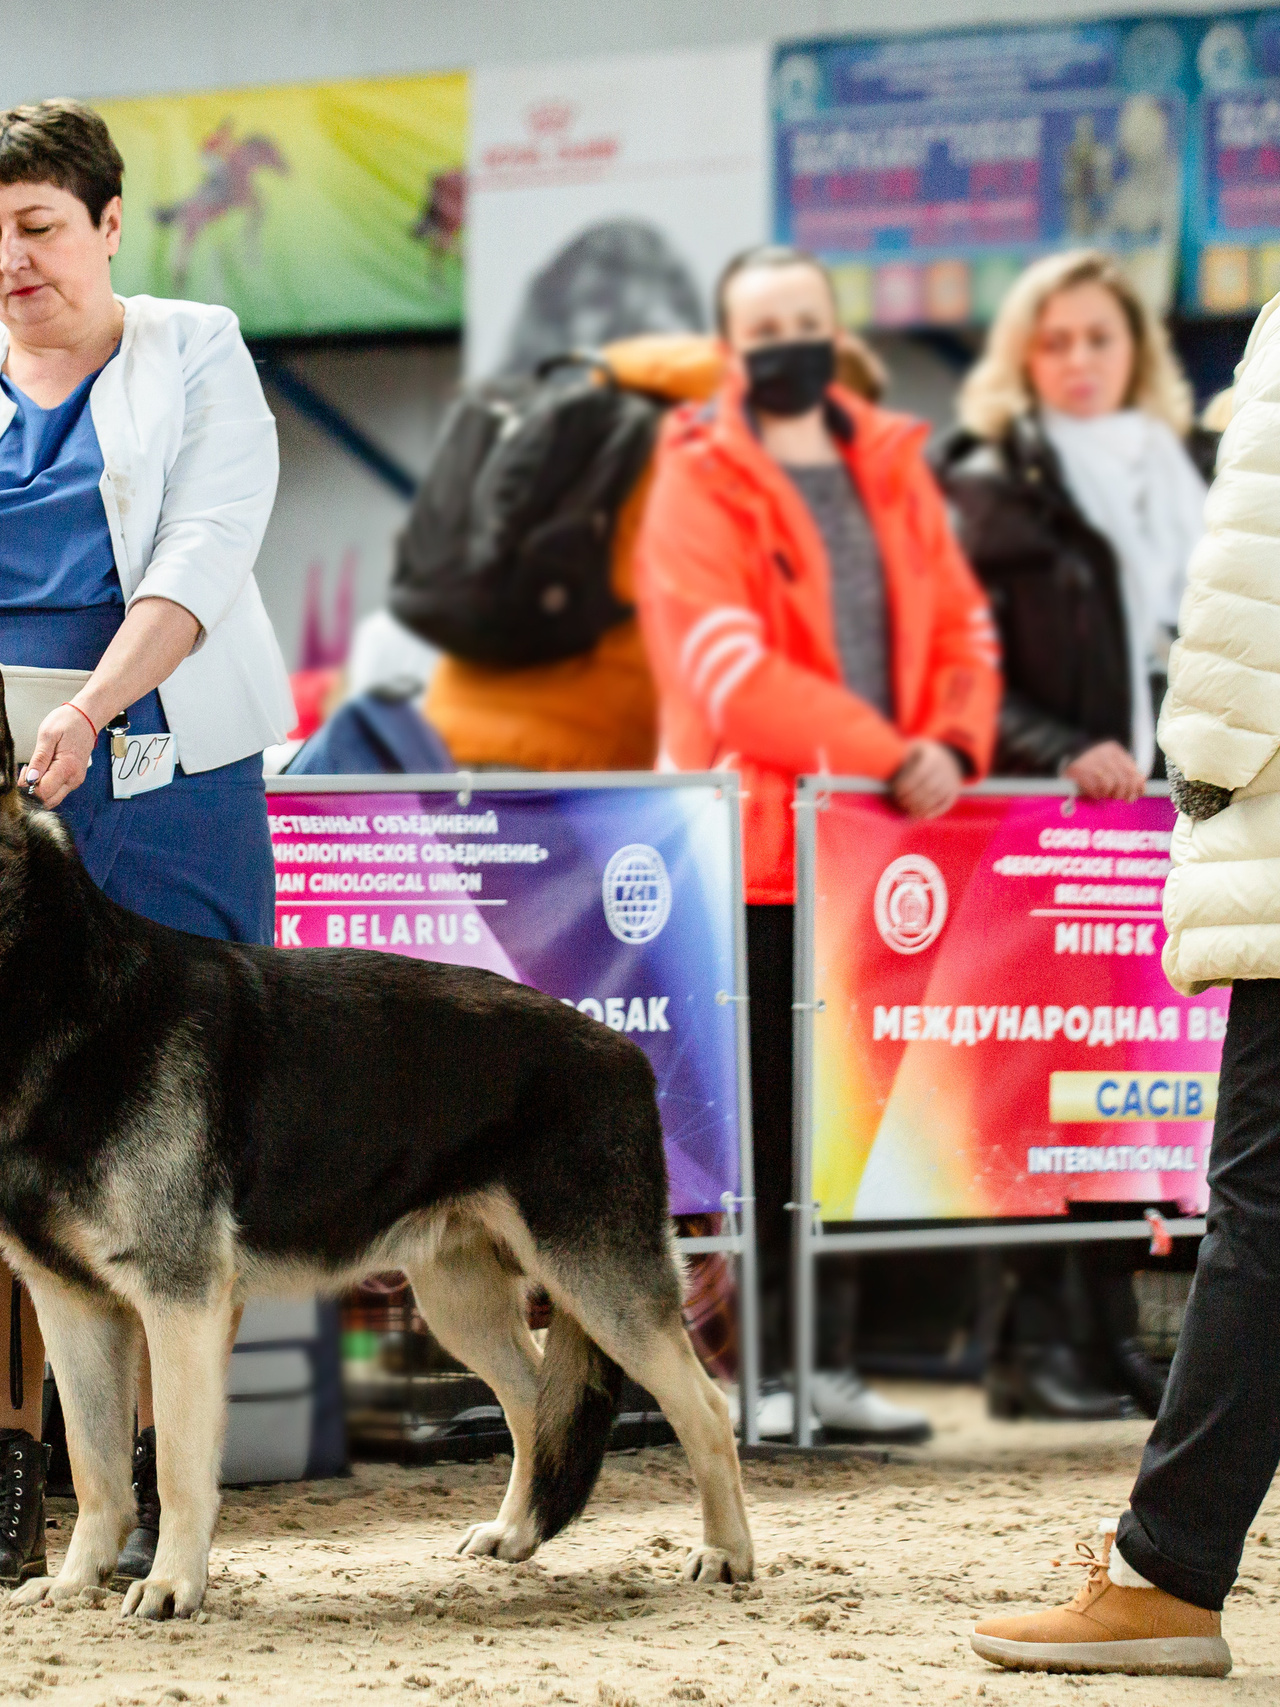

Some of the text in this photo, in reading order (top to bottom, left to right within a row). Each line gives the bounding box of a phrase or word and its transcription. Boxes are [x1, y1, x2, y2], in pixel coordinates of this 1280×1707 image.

[372, 810, 499, 836] ОБЪЕДИНЕНИЙ
[308, 872, 425, 893] CINOLOGICAL
[428, 872, 482, 893] UNION
[326, 913, 482, 946] BELARUS
[1054, 922, 1157, 956] MINSK
[560, 996, 671, 1033] ОБАК
[872, 1006, 1180, 1047] МЕЖДУНАРОДНАЯ
[1096, 1079, 1204, 1117] CACIB
[1027, 1145, 1197, 1173] INTERNATIONAL
